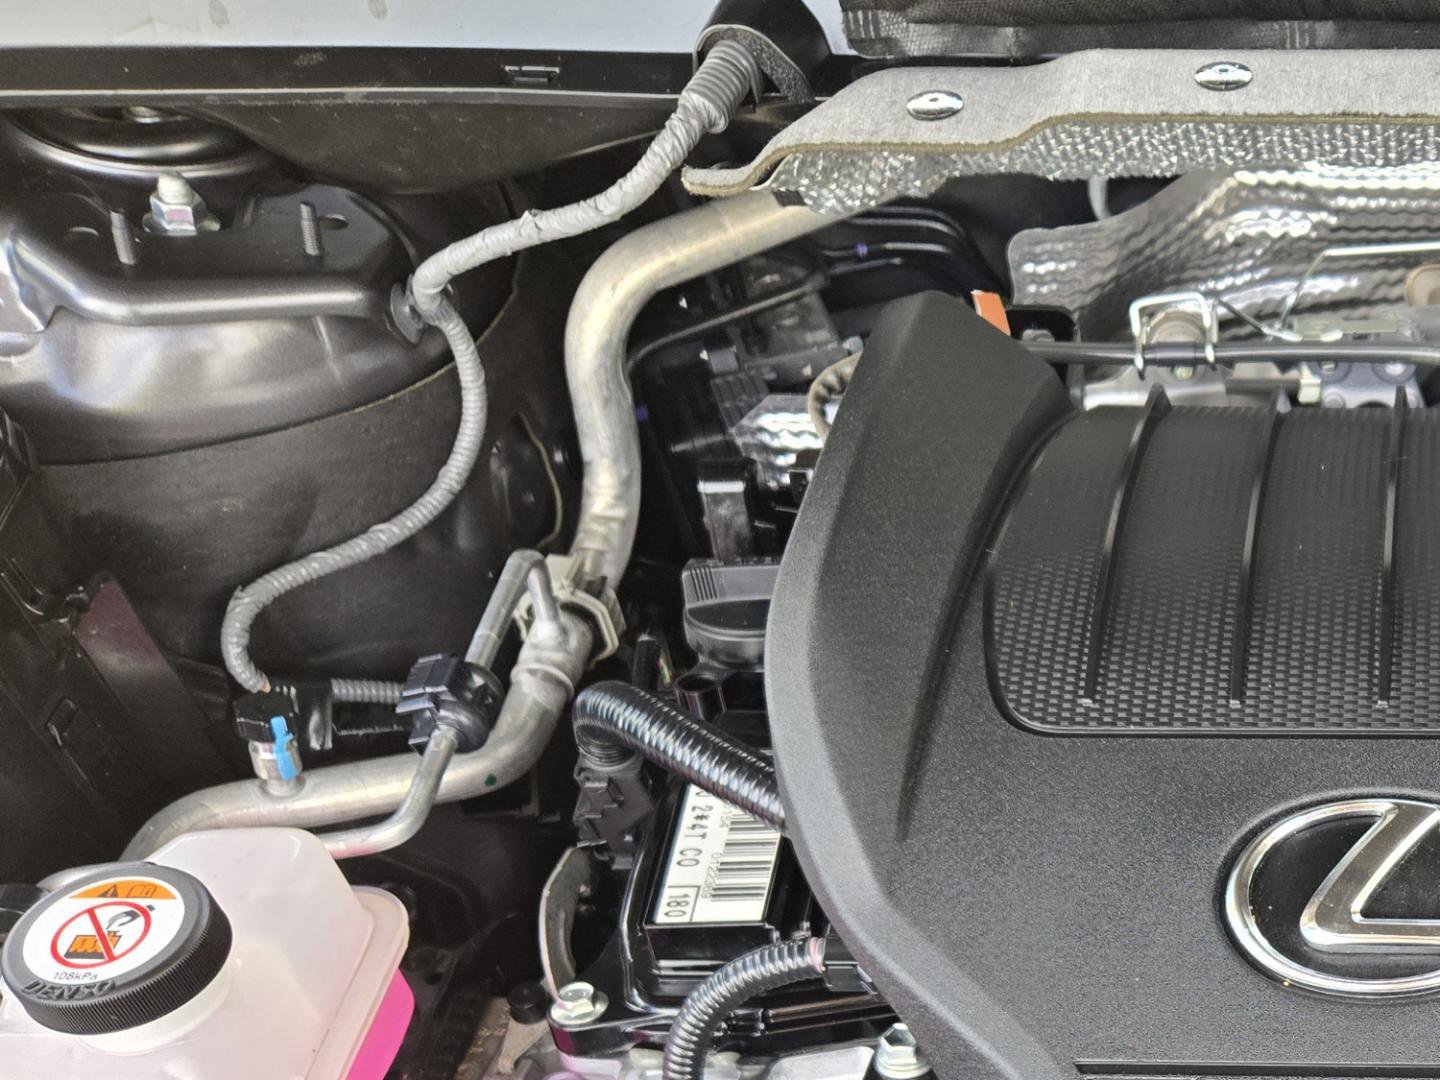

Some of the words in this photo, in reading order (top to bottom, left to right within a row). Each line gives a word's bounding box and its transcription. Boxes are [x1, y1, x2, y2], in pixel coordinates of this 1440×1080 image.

[663, 892, 691, 918] 180
[52, 971, 98, 981] 108kPa
[21, 979, 117, 1000] DENSO
